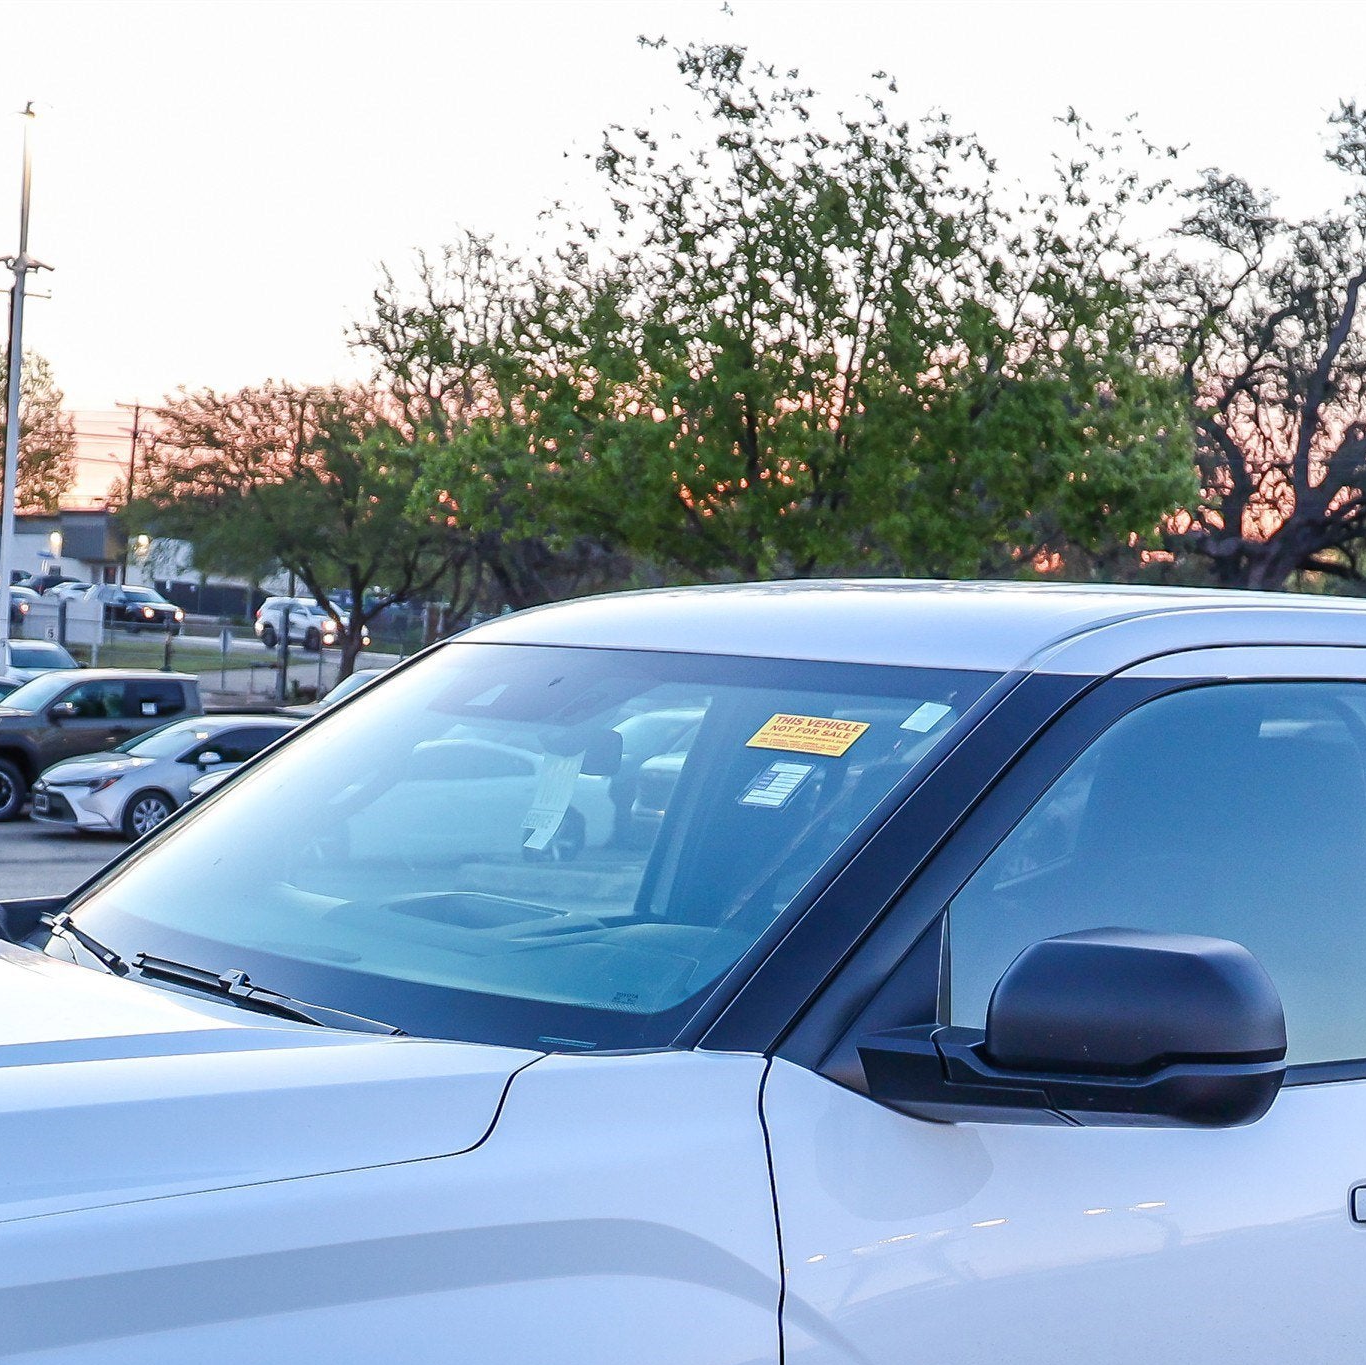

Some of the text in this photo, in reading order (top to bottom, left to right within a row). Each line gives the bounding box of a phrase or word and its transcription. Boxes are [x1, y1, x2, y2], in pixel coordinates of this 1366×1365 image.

[770, 725, 853, 739] NOT FOR SALE
[775, 715, 864, 733] THIS VEHICLE
